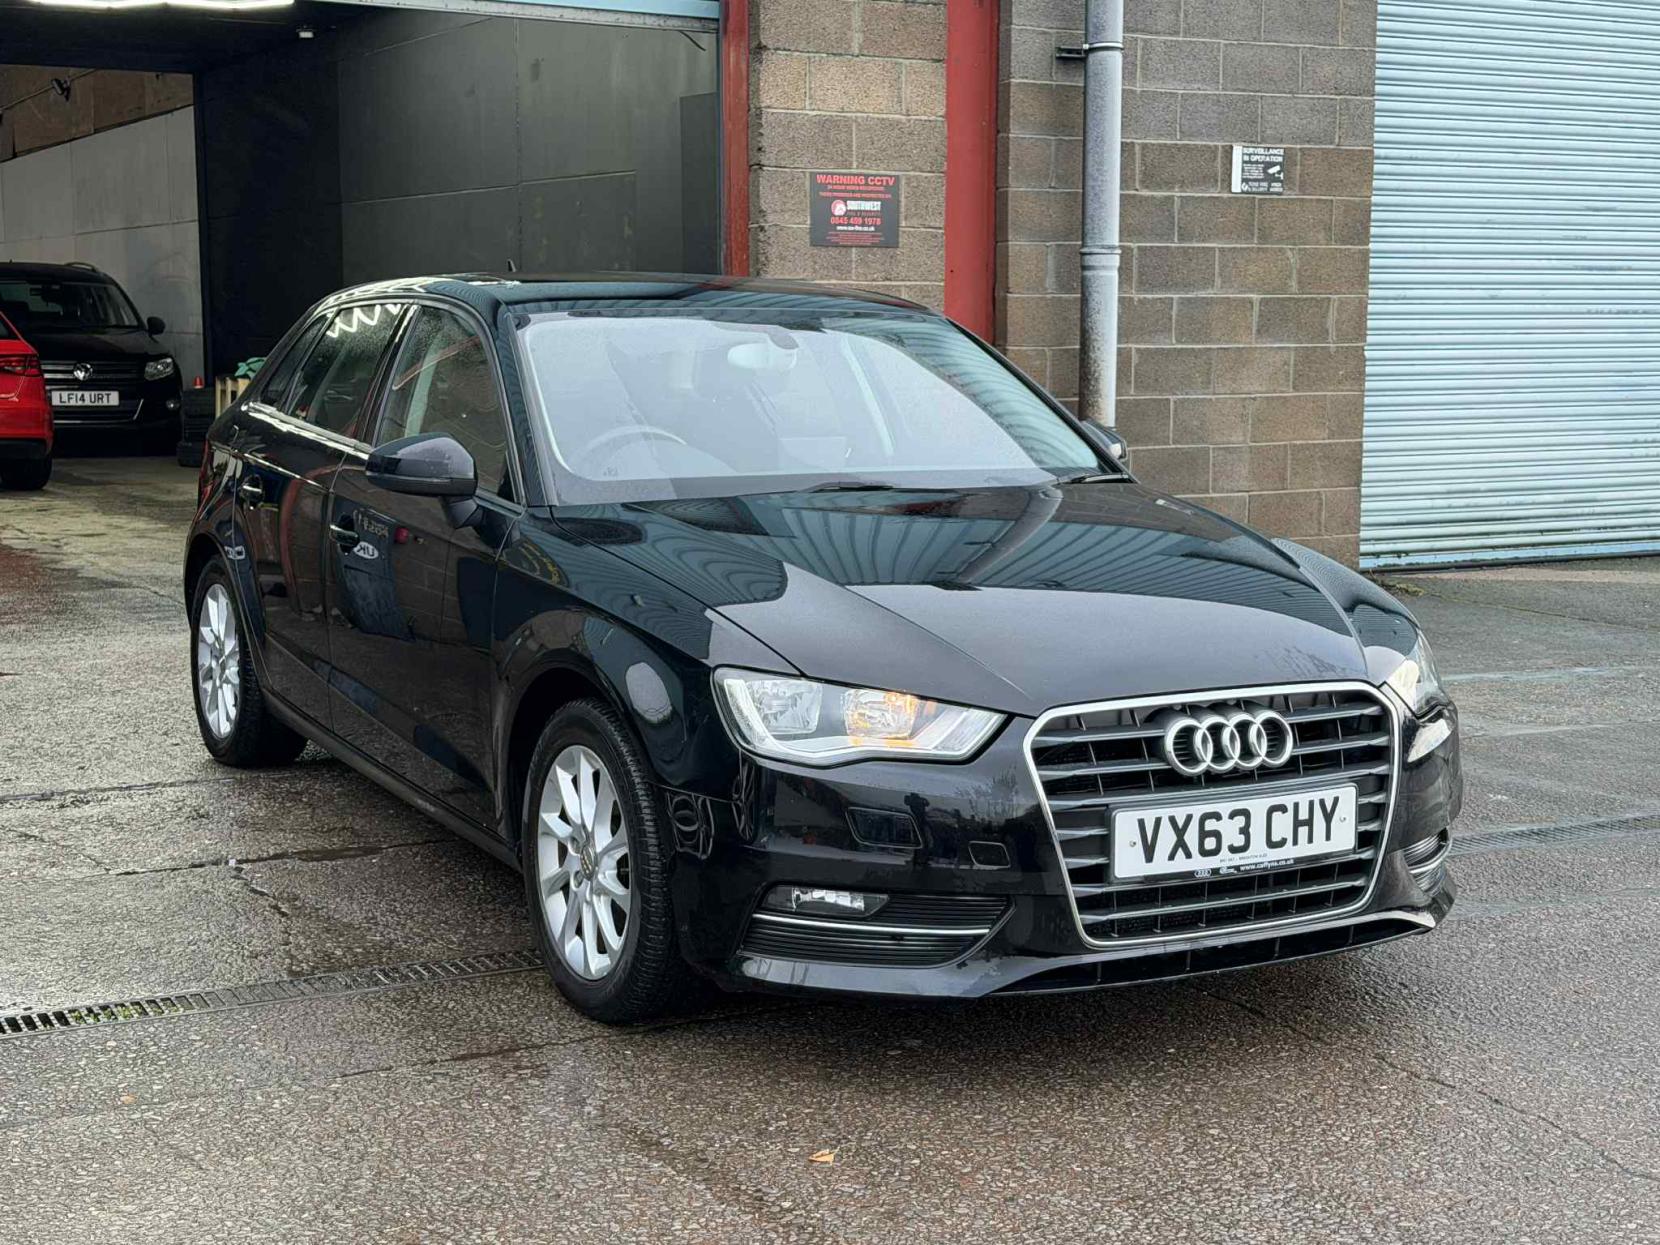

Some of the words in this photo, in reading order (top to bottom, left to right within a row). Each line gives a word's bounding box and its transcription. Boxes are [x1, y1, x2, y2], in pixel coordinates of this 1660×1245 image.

[816, 174, 865, 185] WARNING
[868, 176, 895, 186] CCTV
[59, 392, 86, 404] LF14
[89, 392, 112, 404] URT
[1137, 808, 1252, 864] VX63
[1265, 795, 1340, 850] CHY
